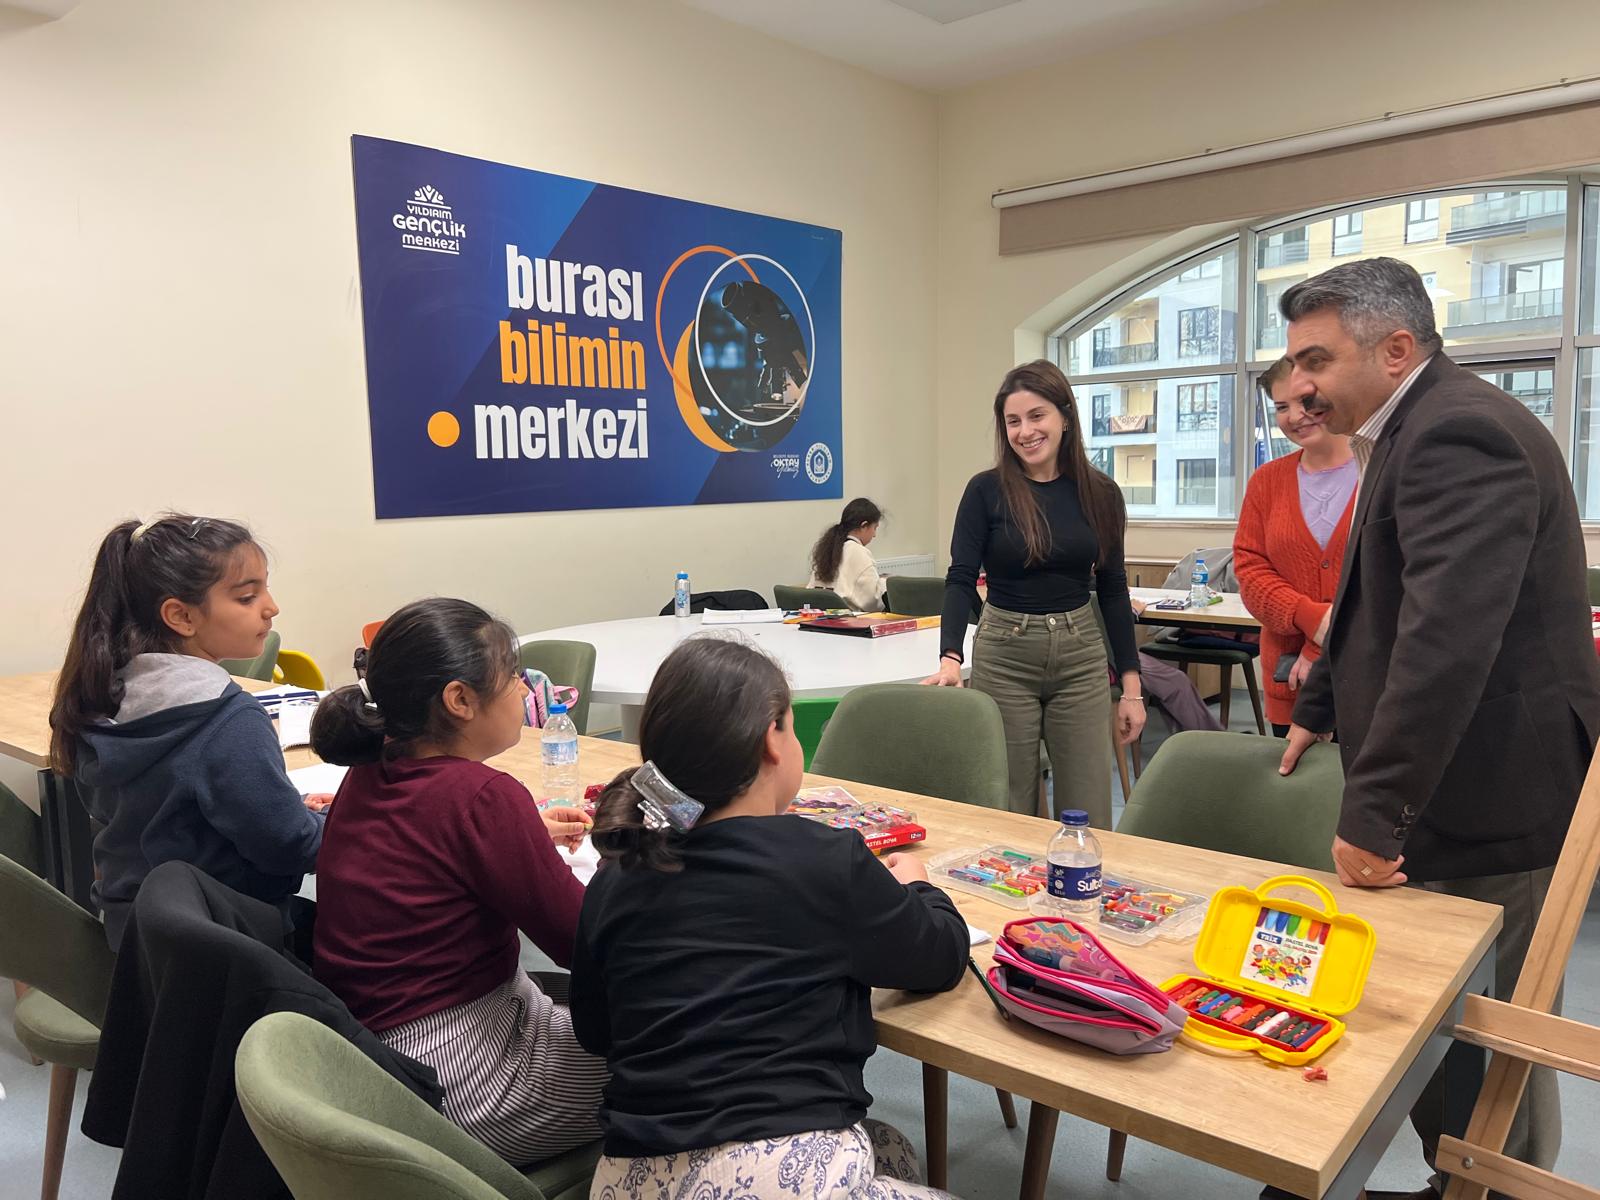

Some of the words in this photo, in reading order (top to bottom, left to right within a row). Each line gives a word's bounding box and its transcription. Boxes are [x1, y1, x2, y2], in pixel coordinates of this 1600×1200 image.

[406, 204, 452, 220] YILDIRIM
[505, 243, 644, 322] burası
[498, 318, 646, 391] bilimin
[474, 397, 649, 460] merkezi
[773, 458, 800, 467] OKTAY
[866, 840, 883, 848] ASTEL
